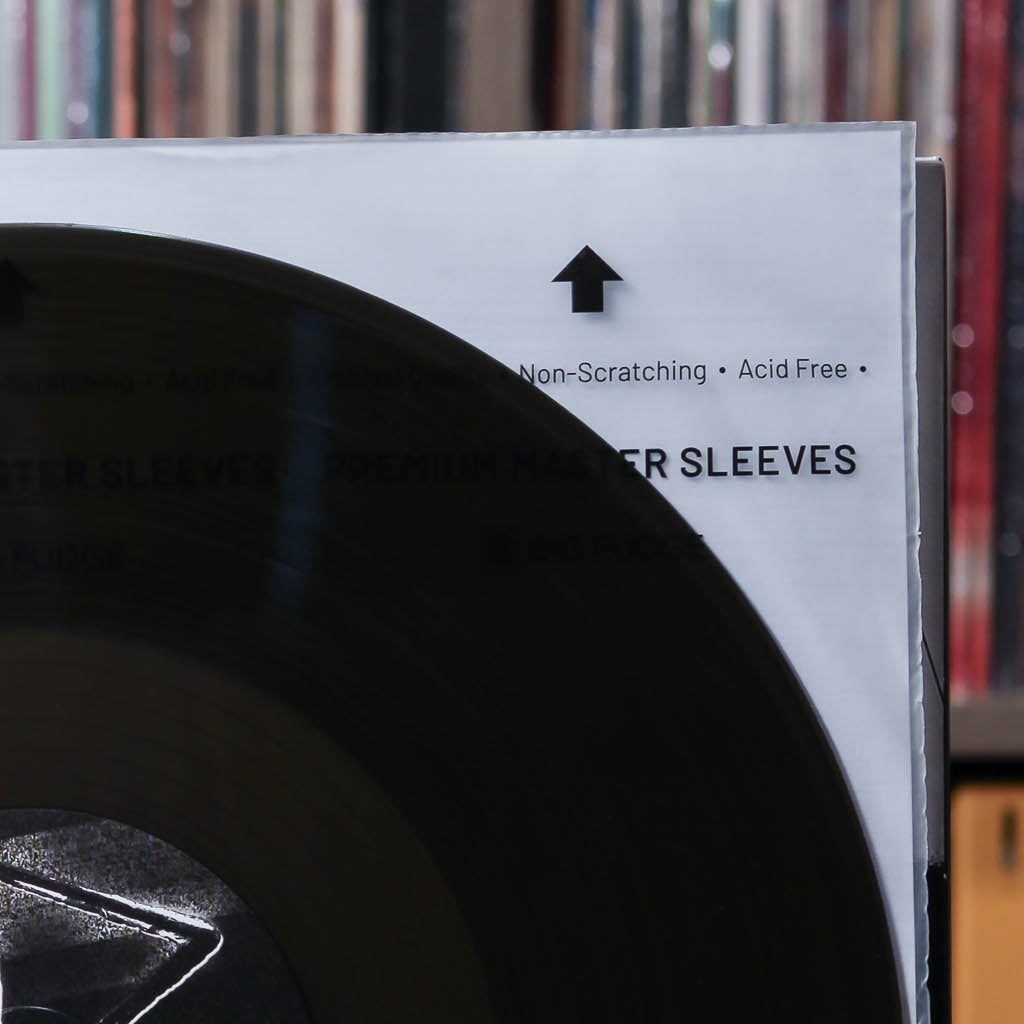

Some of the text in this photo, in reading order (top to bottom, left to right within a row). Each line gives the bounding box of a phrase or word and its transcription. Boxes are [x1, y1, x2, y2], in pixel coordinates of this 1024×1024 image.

[519, 357, 848, 385] Non-Scratching Acid Free
[680, 444, 857, 478] SLEEVES
